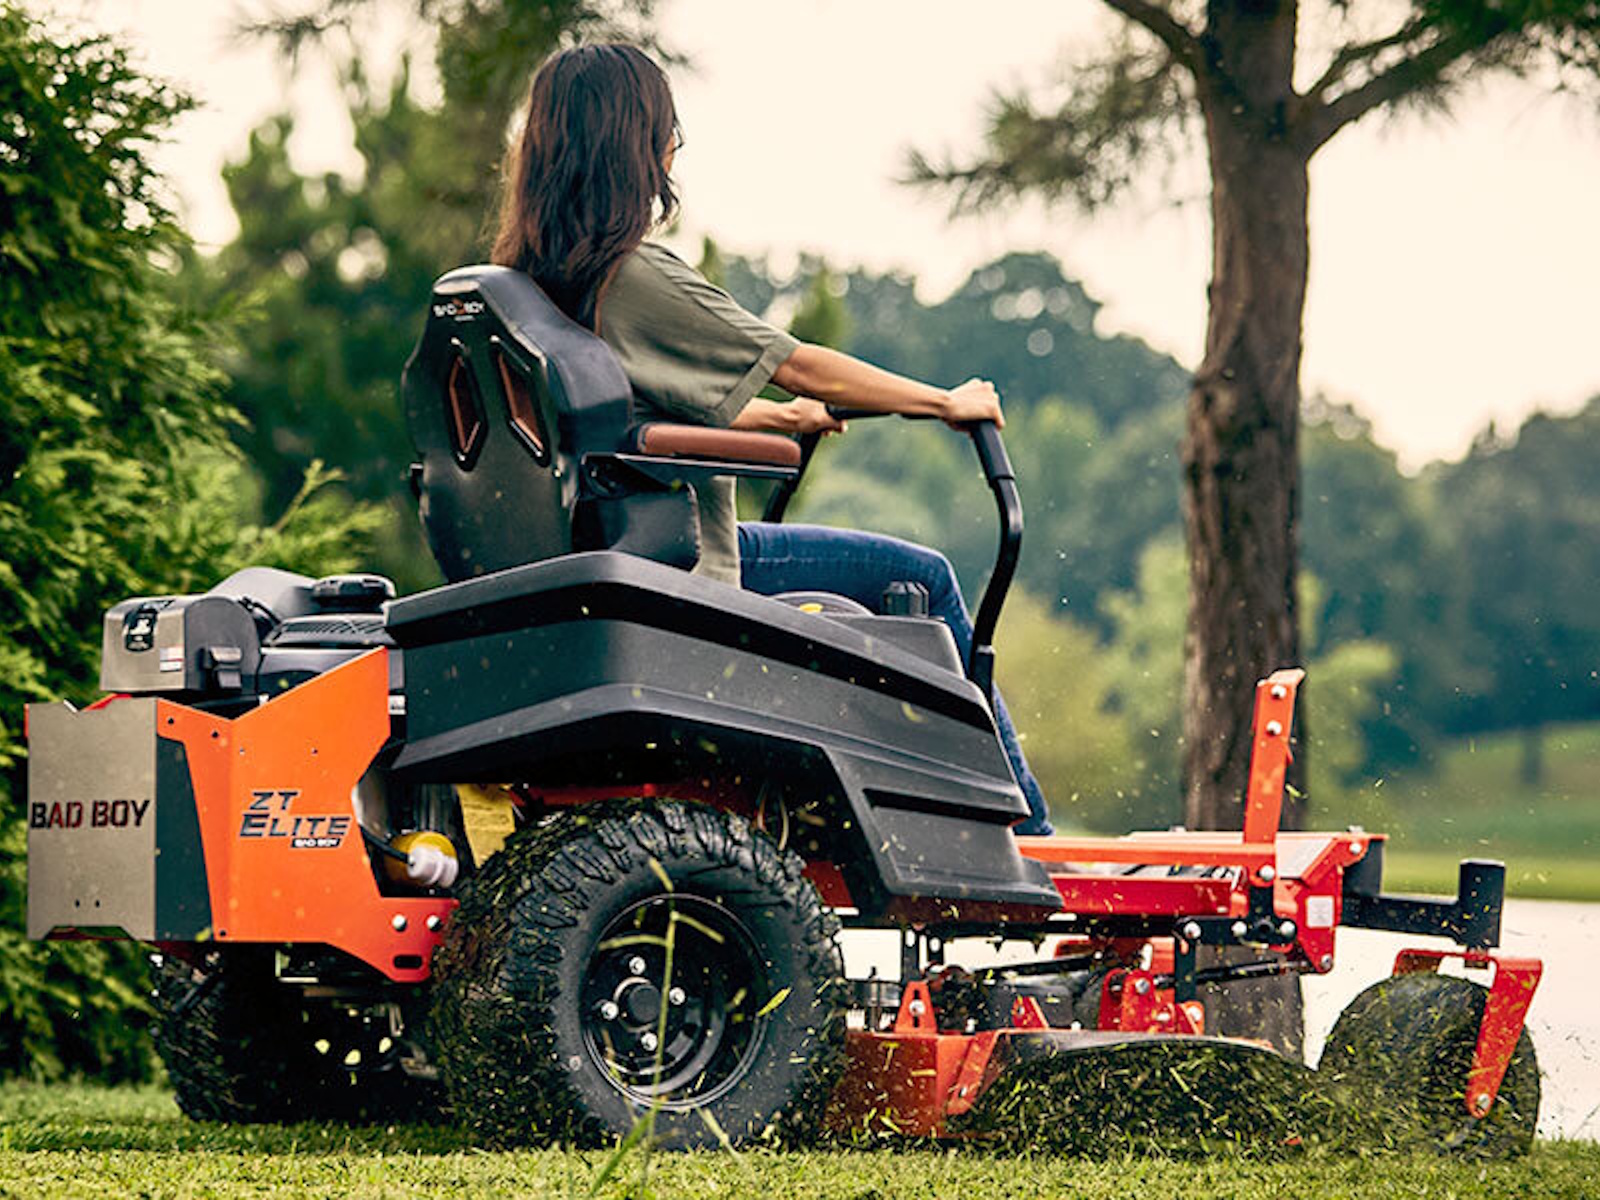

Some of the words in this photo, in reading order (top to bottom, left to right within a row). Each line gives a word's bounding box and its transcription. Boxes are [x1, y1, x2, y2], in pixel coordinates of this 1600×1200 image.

[249, 791, 298, 810] ZT
[31, 801, 83, 828] BAD
[92, 800, 150, 827] BOY
[240, 813, 350, 836] ELITE
